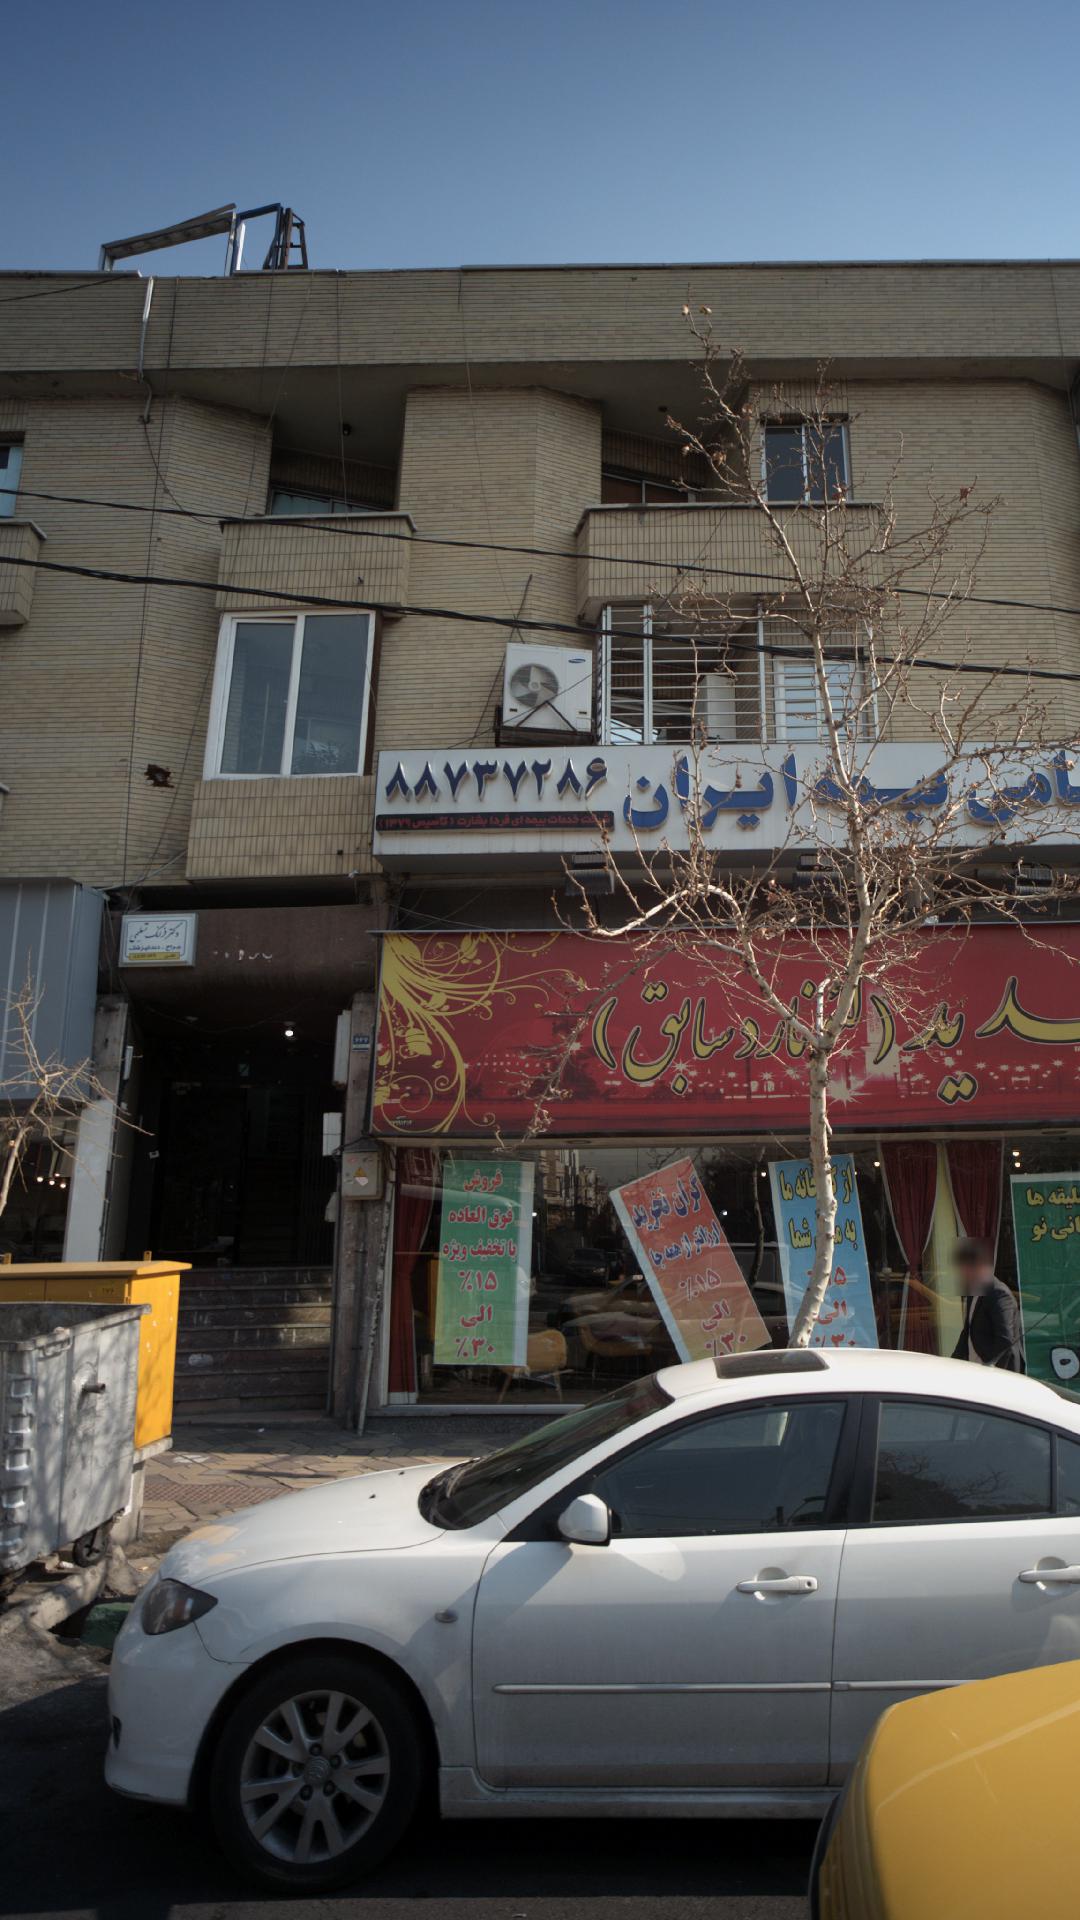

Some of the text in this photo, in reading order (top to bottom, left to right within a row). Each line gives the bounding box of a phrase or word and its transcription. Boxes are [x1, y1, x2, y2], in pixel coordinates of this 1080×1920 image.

[385, 756, 608, 801] ۸۸۷۳۷۲۸۶
[622, 752, 797, 831] ایران
[464, 1168, 503, 1193] فروش
[779, 1170, 794, 1201] ما
[841, 1163, 854, 1204] از
[1025, 1187, 1045, 1207] ها
[448, 1205, 514, 1230] فوق العاده
[1031, 1215, 1048, 1242] نو
[788, 1217, 812, 1249] شما
[443, 1238, 518, 1263] با تخفیف ویژه
[460, 1304, 493, 1328] الی
[702, 1298, 731, 1332] الی
[817, 1300, 847, 1325] الی
